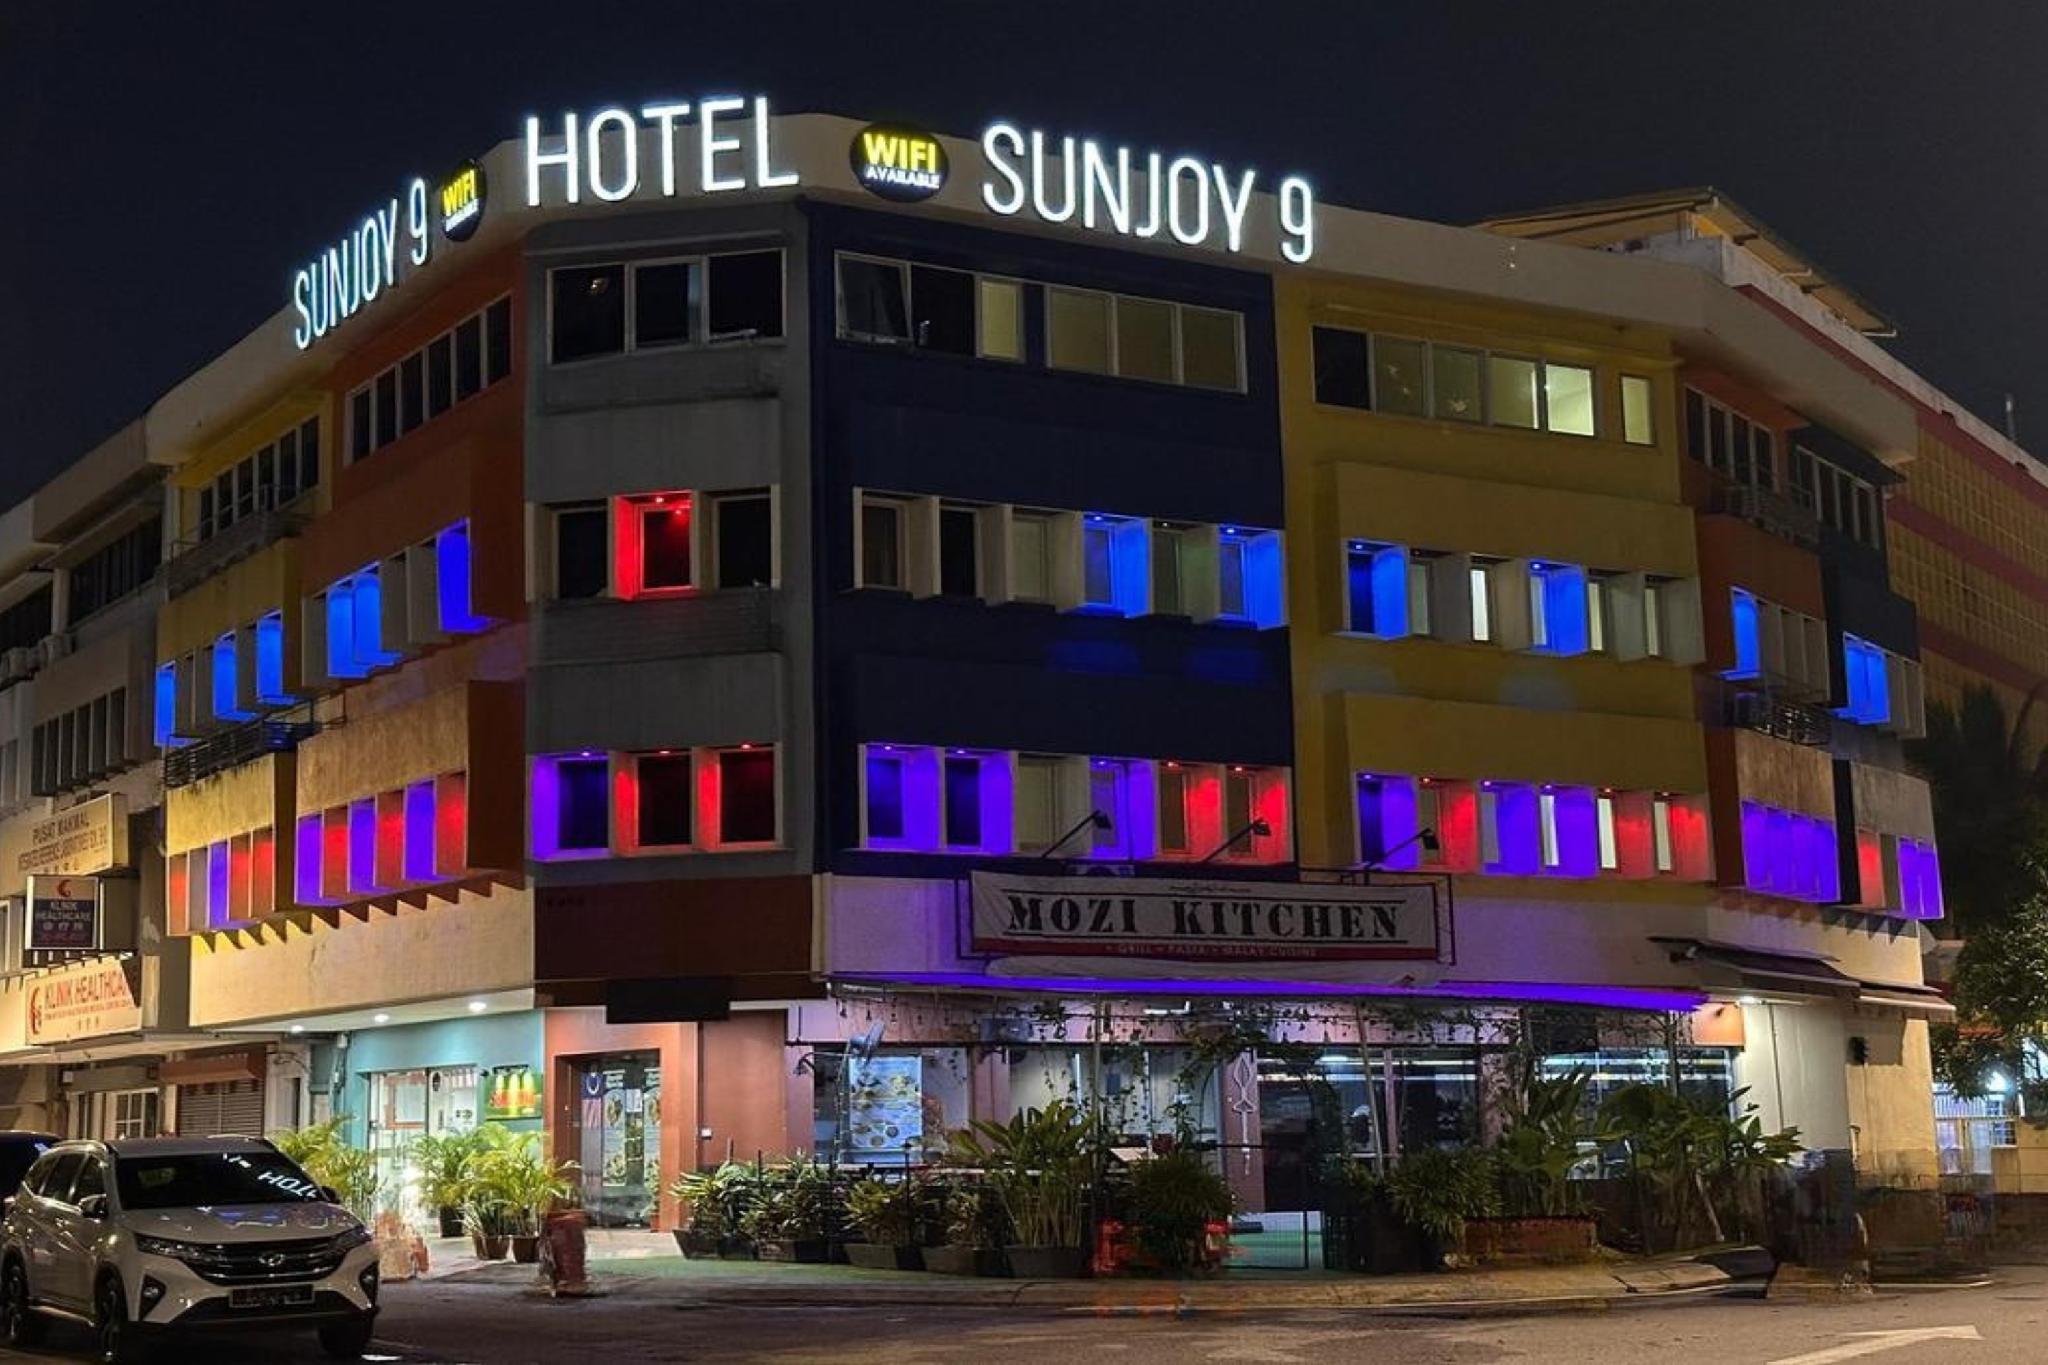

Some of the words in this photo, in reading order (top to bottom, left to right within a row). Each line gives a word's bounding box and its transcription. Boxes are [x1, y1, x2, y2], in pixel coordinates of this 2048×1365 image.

[527, 97, 800, 207] HOTEL
[863, 133, 936, 174] WIFI
[444, 169, 477, 216] WIFI
[866, 165, 940, 190] AVAILABLE
[984, 123, 1256, 252] SUNJOY
[1281, 177, 1314, 264] 9
[295, 198, 398, 350] SUNJOY
[409, 177, 428, 266] 9
[1008, 896, 1137, 933] MOZI
[1172, 900, 1397, 937] KITCHEN
